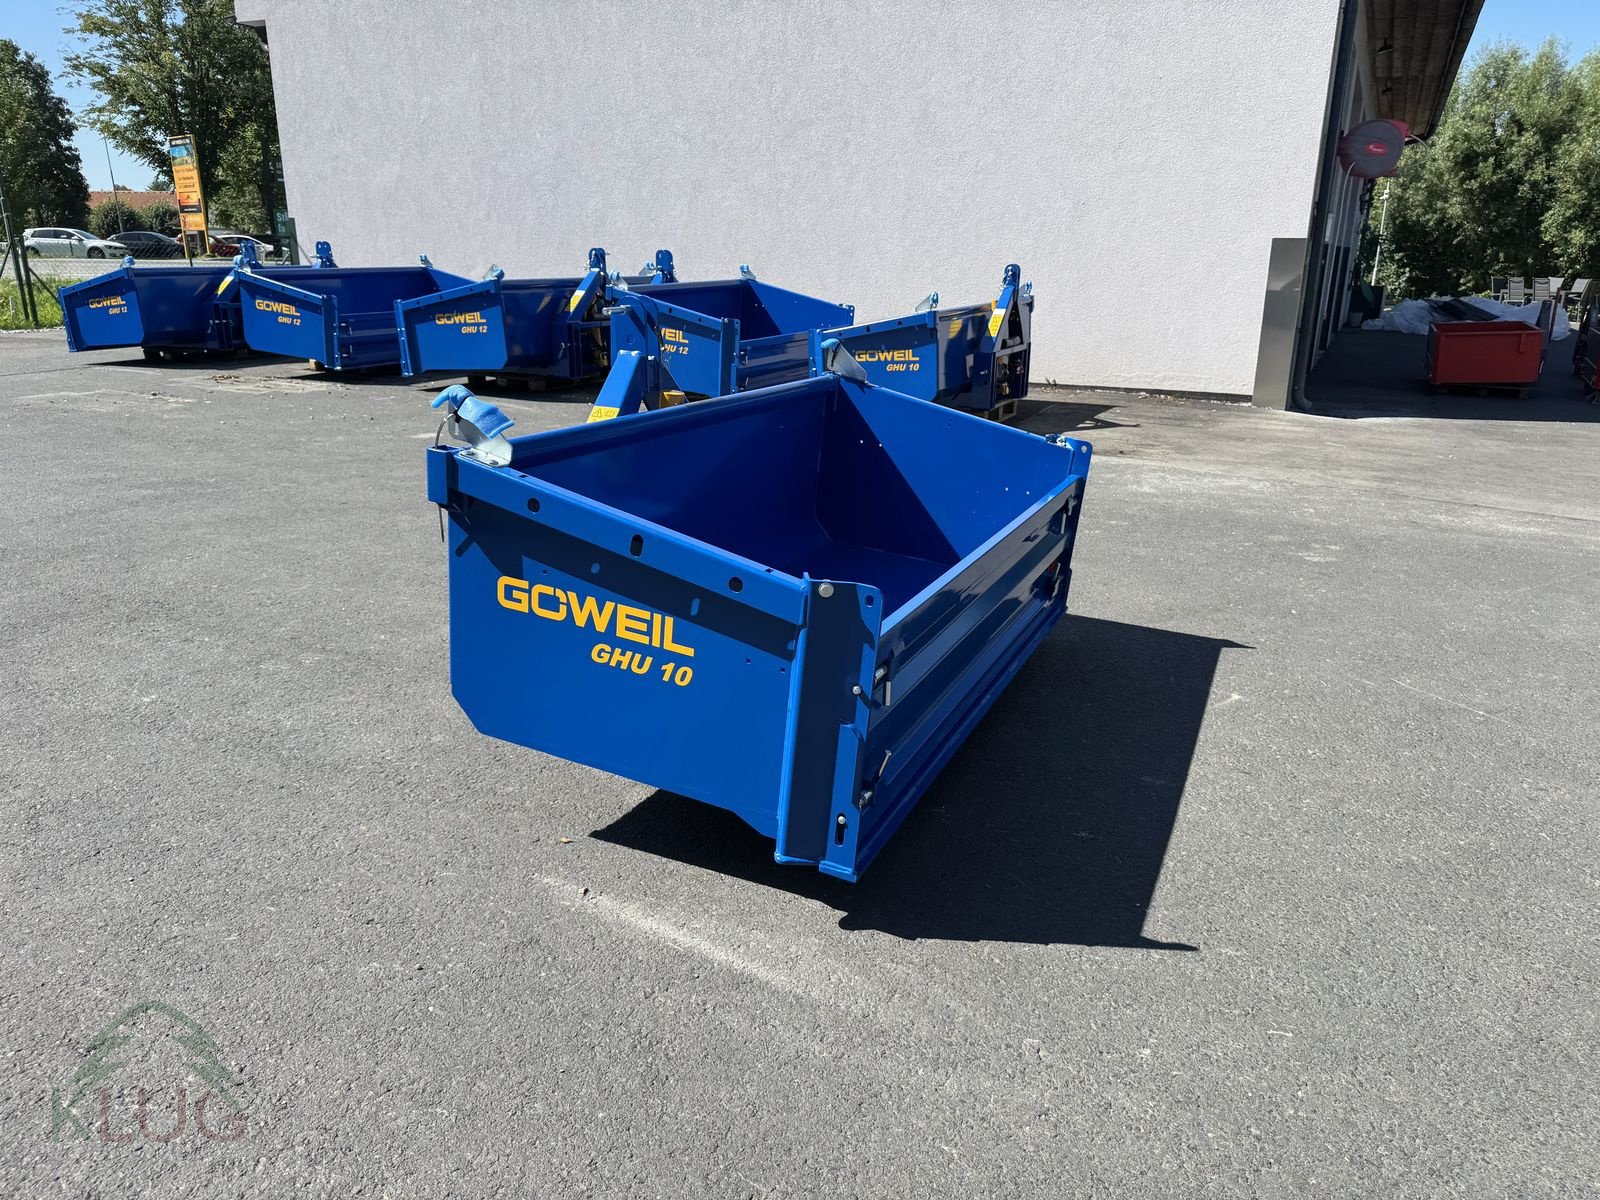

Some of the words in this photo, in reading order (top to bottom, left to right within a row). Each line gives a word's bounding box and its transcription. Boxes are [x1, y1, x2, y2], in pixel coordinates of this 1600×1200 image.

[278, 316, 292, 324] GHU
[293, 318, 301, 326] 12
[461, 326, 478, 334] GHU
[479, 325, 488, 333] 12
[661, 328, 689, 343] EIL
[678, 347, 689, 355] 12
[886, 363, 907, 372] GHU
[908, 363, 920, 372] 10
[591, 643, 653, 675] GHU
[661, 661, 694, 687] 10
